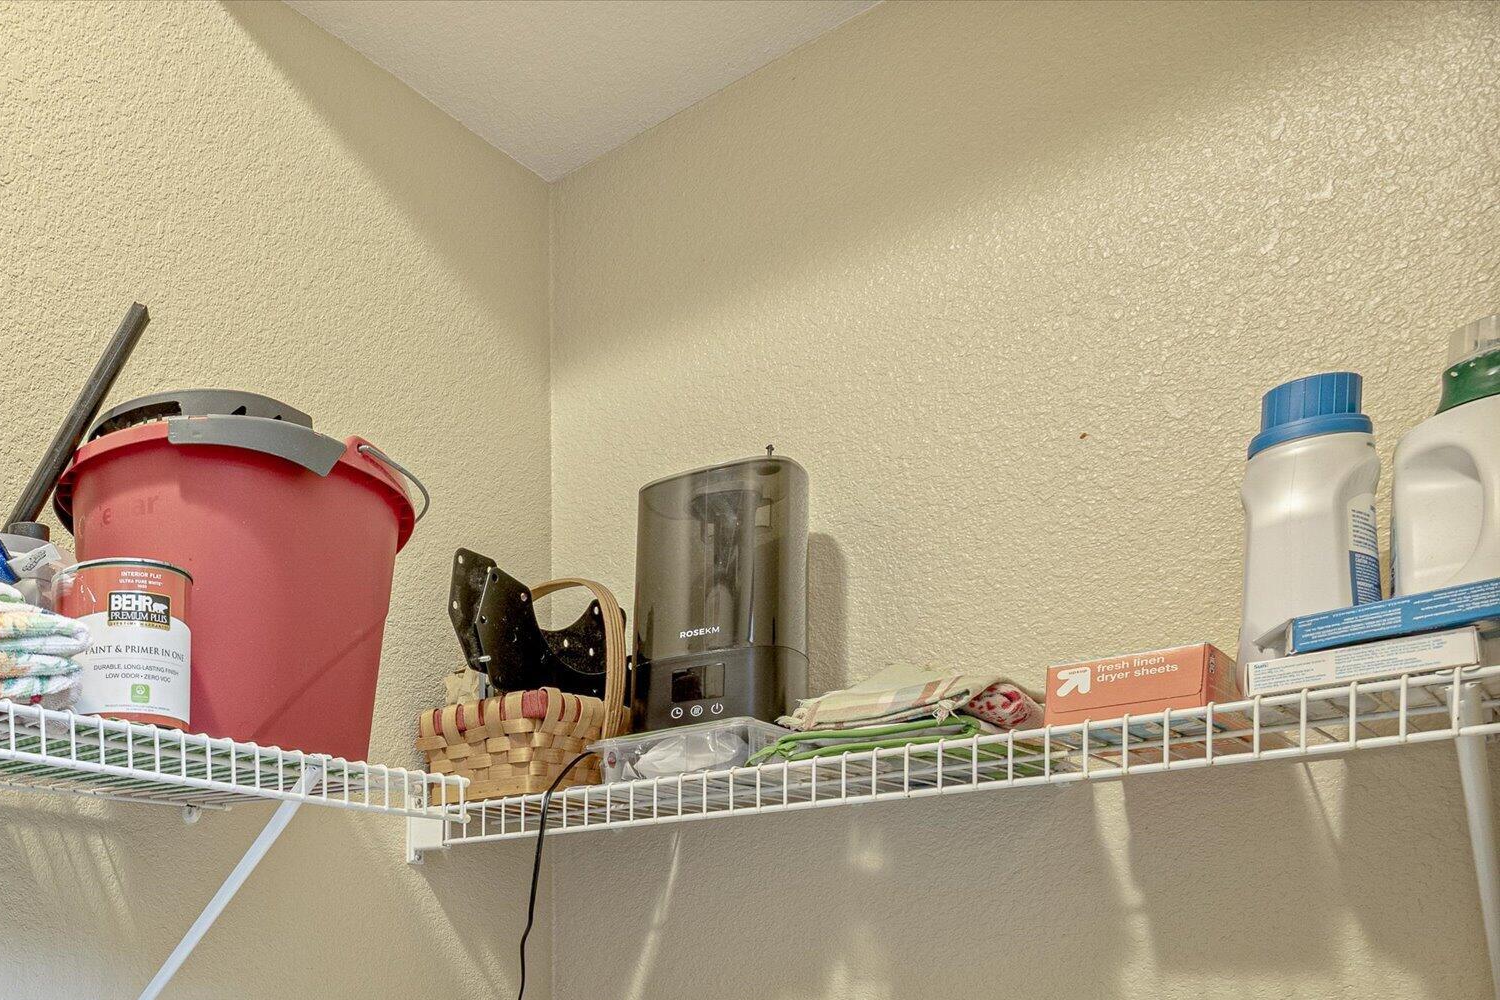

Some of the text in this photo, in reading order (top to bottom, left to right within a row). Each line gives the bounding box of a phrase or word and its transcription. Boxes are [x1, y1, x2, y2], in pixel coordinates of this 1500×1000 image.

[121, 571, 162, 580] INTERIOR FLAT
[110, 593, 153, 613] BEHR
[110, 611, 168, 625] PREMIUM PLUS
[679, 625, 721, 639] ROSEKM
[114, 644, 123, 654] &
[125, 645, 160, 656] PRIMER
[161, 648, 171, 657] IN
[171, 651, 185, 663] ONE
[93, 663, 123, 671] DURABLE,
[123, 663, 165, 674] LONG-LASTING
[1097, 655, 1165, 673] fresh linen
[143, 673, 160, 681] ZERO
[160, 675, 172, 683] VOC
[1096, 662, 1179, 683] dryer sheets
